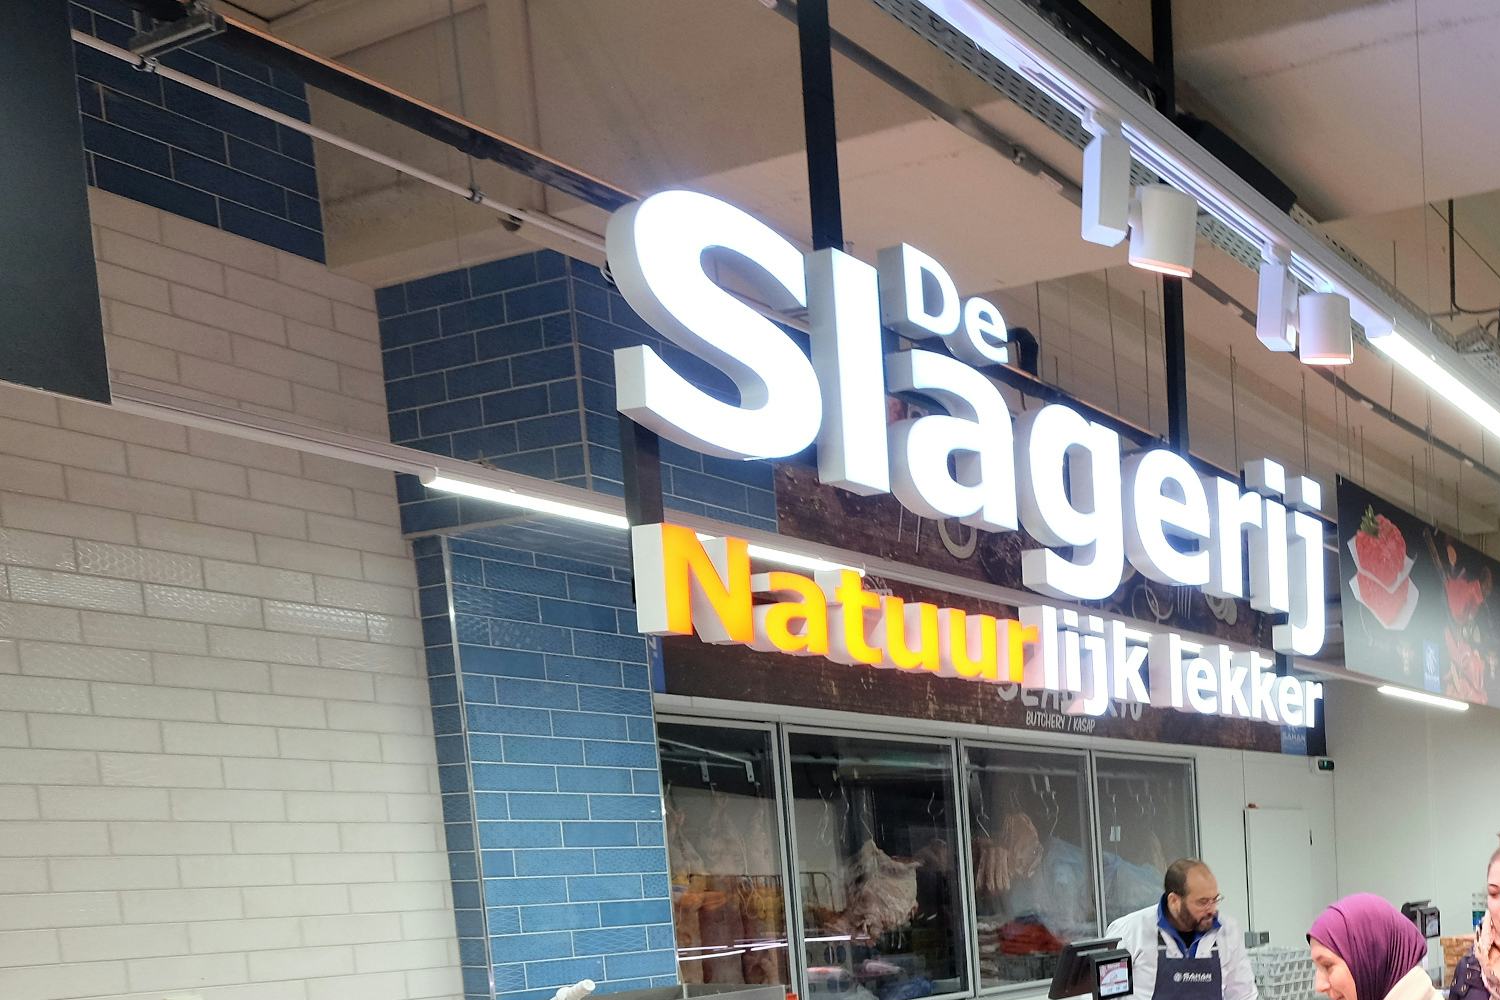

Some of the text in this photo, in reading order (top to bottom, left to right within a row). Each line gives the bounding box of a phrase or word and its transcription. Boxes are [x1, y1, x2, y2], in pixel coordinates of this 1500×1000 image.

[892, 242, 1010, 365] De
[610, 189, 1325, 657] Slagerij
[640, 523, 1323, 729] Natuurlijk lekker
[1025, 710, 1066, 730] BUTCHERY
